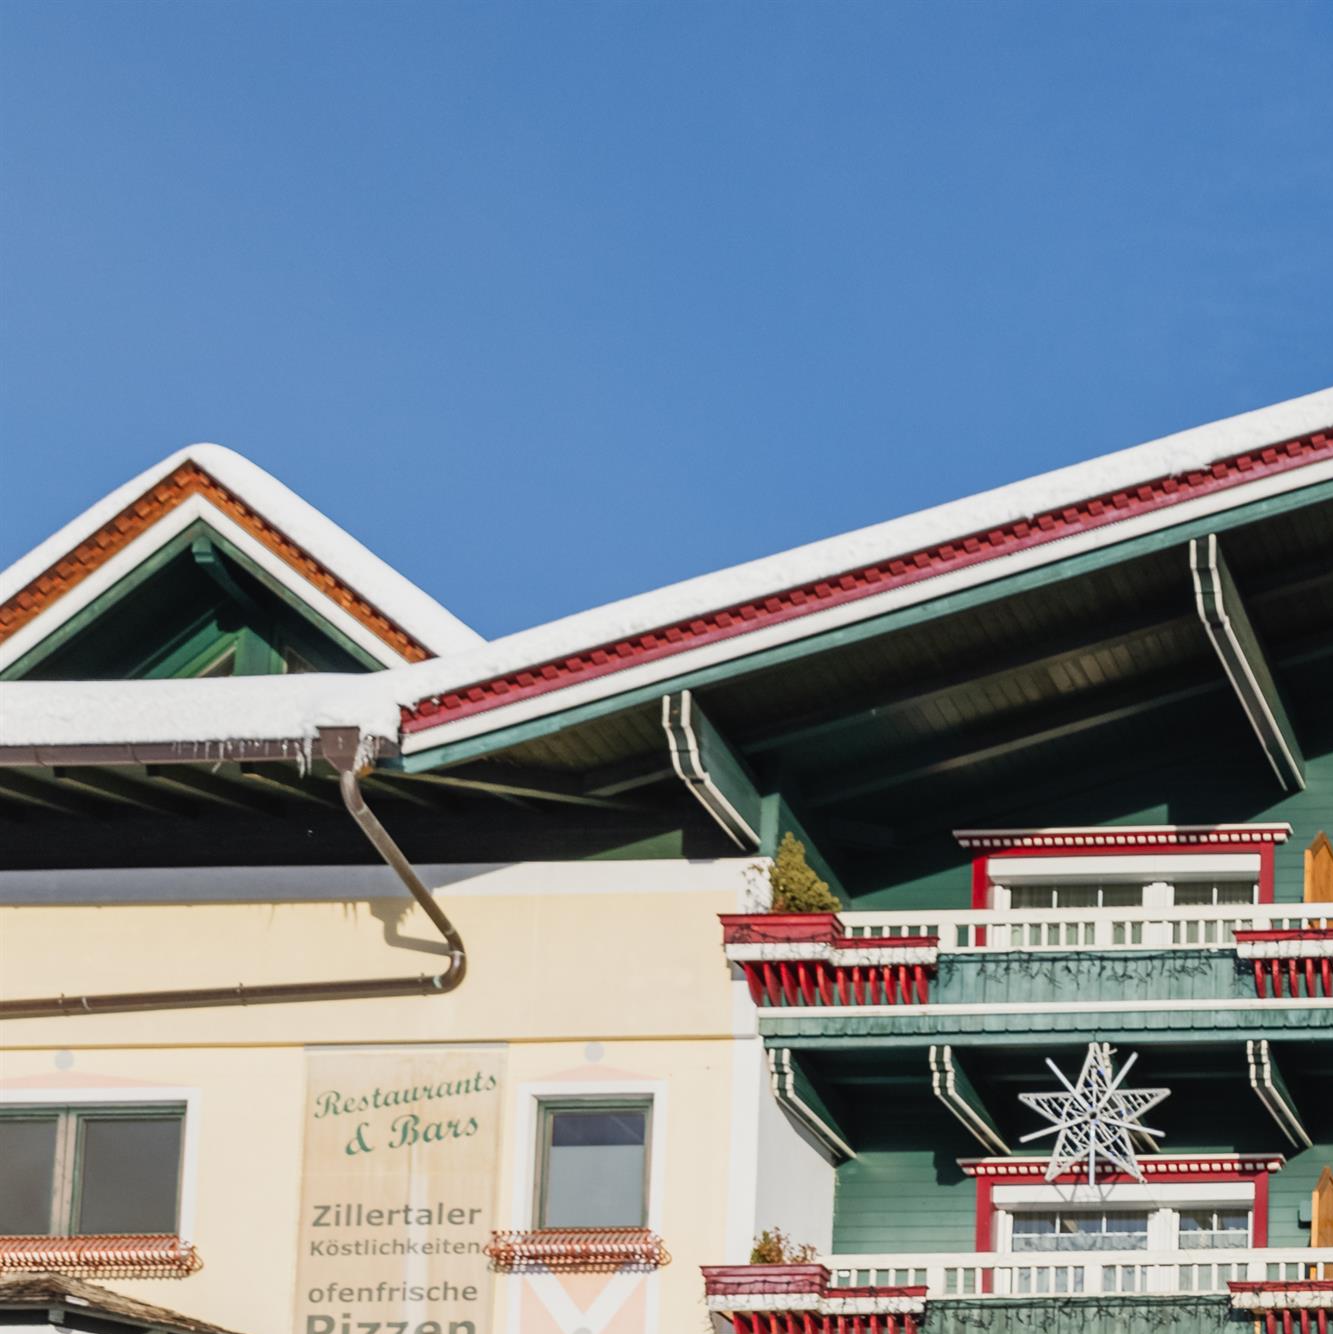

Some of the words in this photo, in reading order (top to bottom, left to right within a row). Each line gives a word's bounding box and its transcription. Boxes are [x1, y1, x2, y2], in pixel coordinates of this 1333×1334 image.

[314, 1071, 497, 1118] Restaurants
[345, 1121, 375, 1156] &
[388, 1113, 480, 1149] Bars
[312, 1203, 482, 1228] Zillertaler
[309, 1239, 481, 1257] Köstlichkeiten
[308, 1282, 479, 1303] ofenfrische
